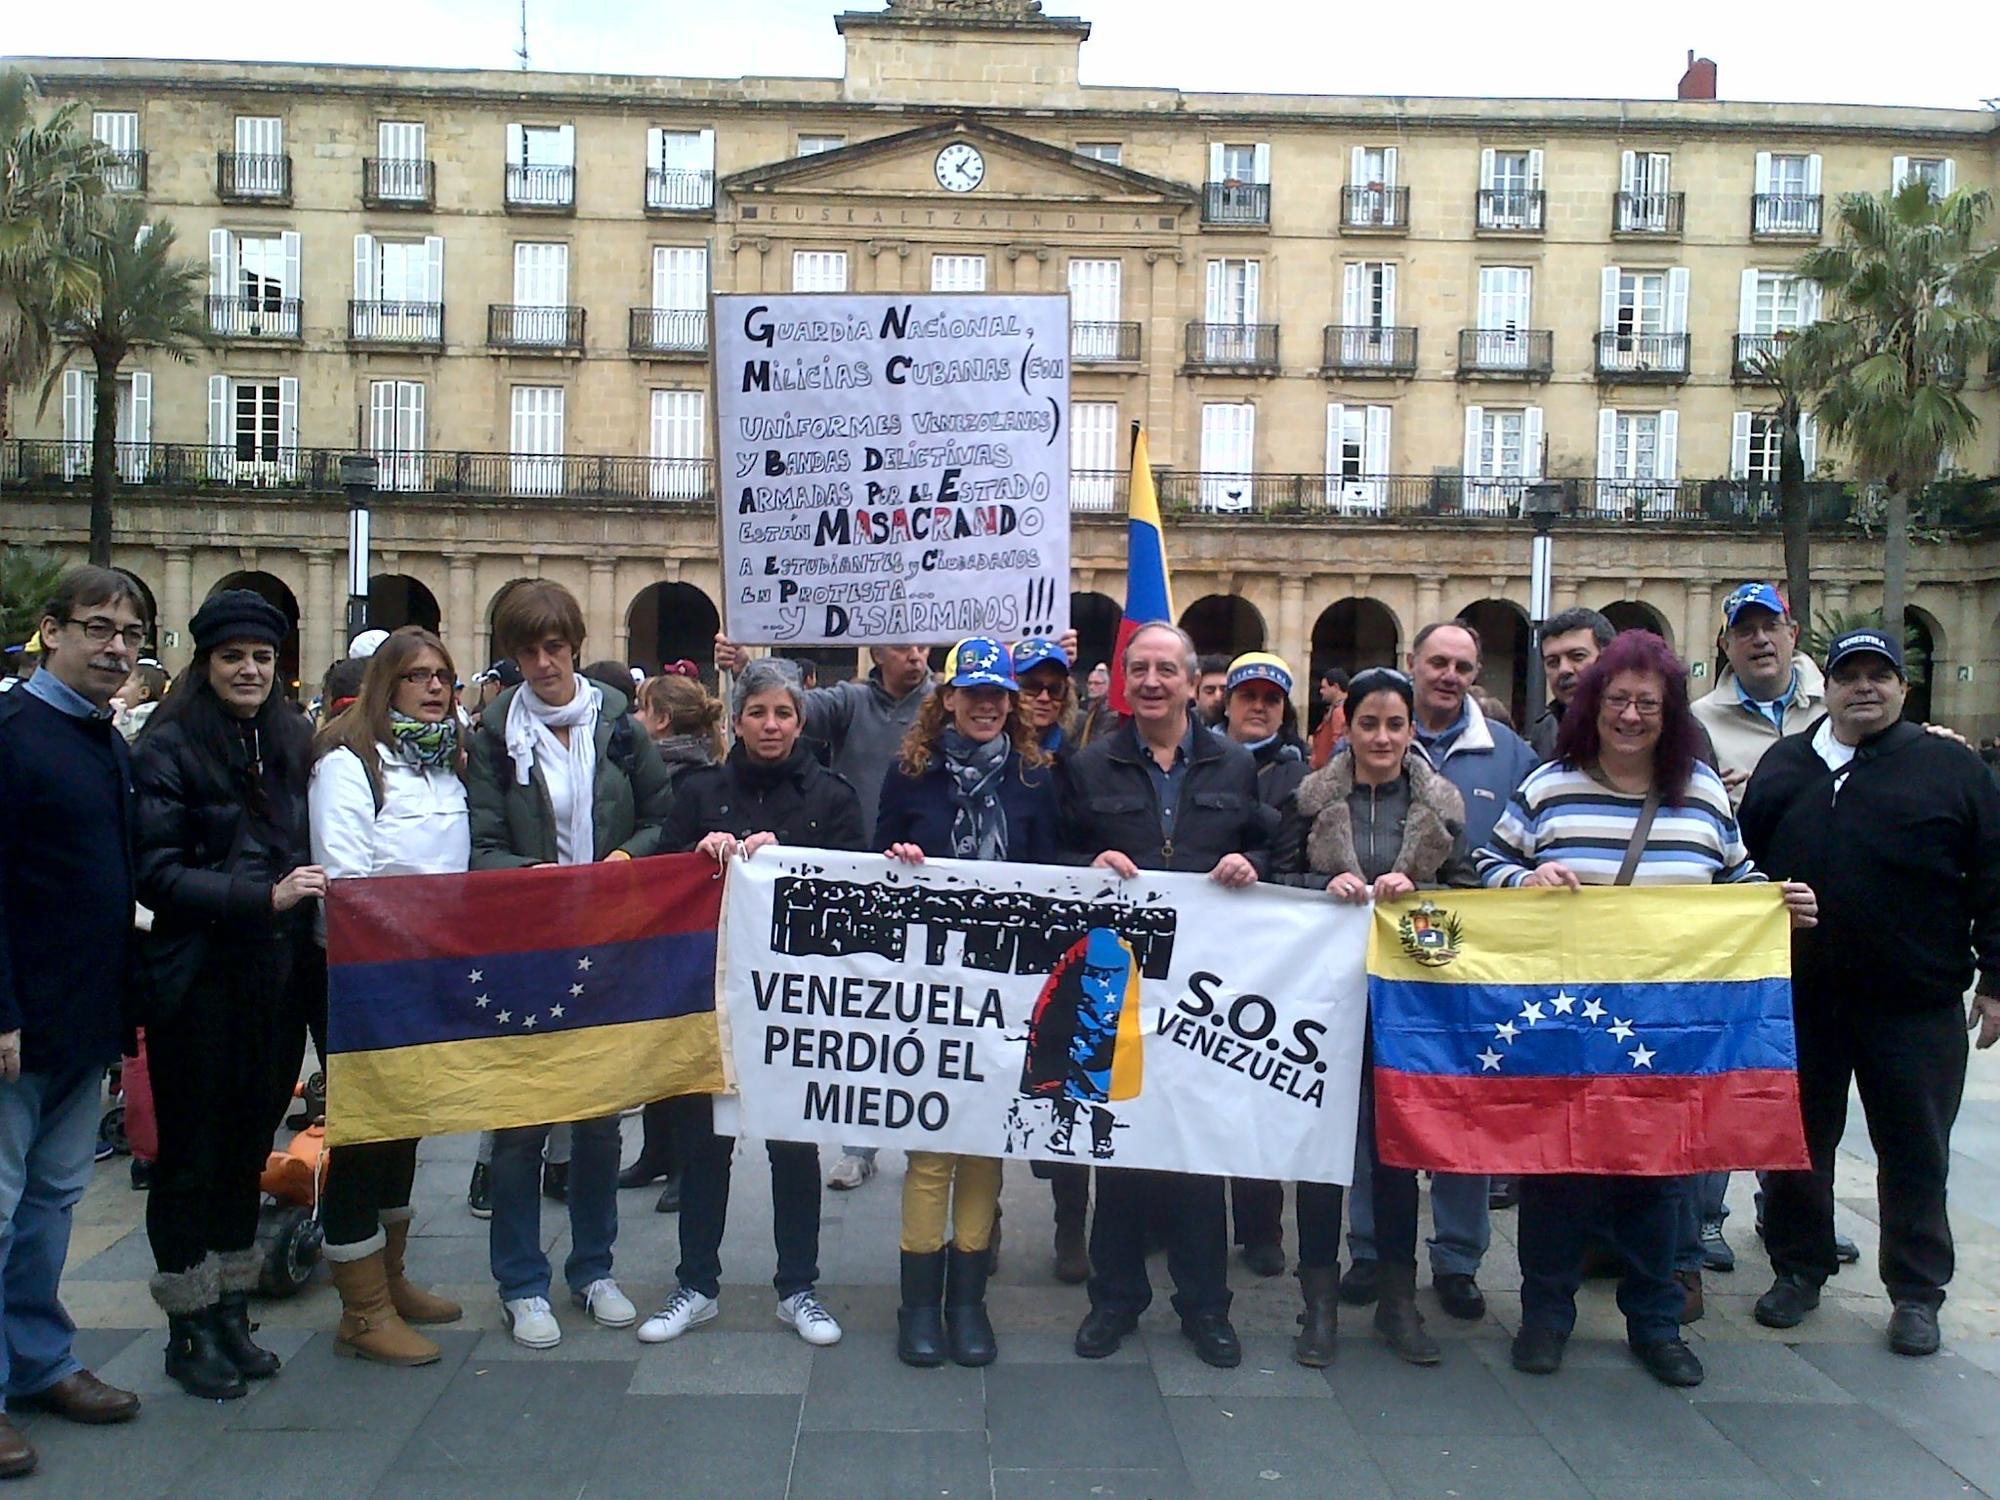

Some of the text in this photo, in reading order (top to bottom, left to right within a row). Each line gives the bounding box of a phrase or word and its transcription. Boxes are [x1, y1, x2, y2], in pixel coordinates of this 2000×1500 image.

[769, 205, 1143, 230] EUSKALTZAINDIA
[813, 505, 1044, 547] MASACRANDO
[752, 971, 1006, 1029] VENEZUELA
[1176, 971, 1330, 1075] S.O.S.
[764, 1024, 985, 1083] PERDIÓ EL
[1155, 1007, 1326, 1108] VENEZUELA
[803, 1082, 950, 1132] MIEDO
